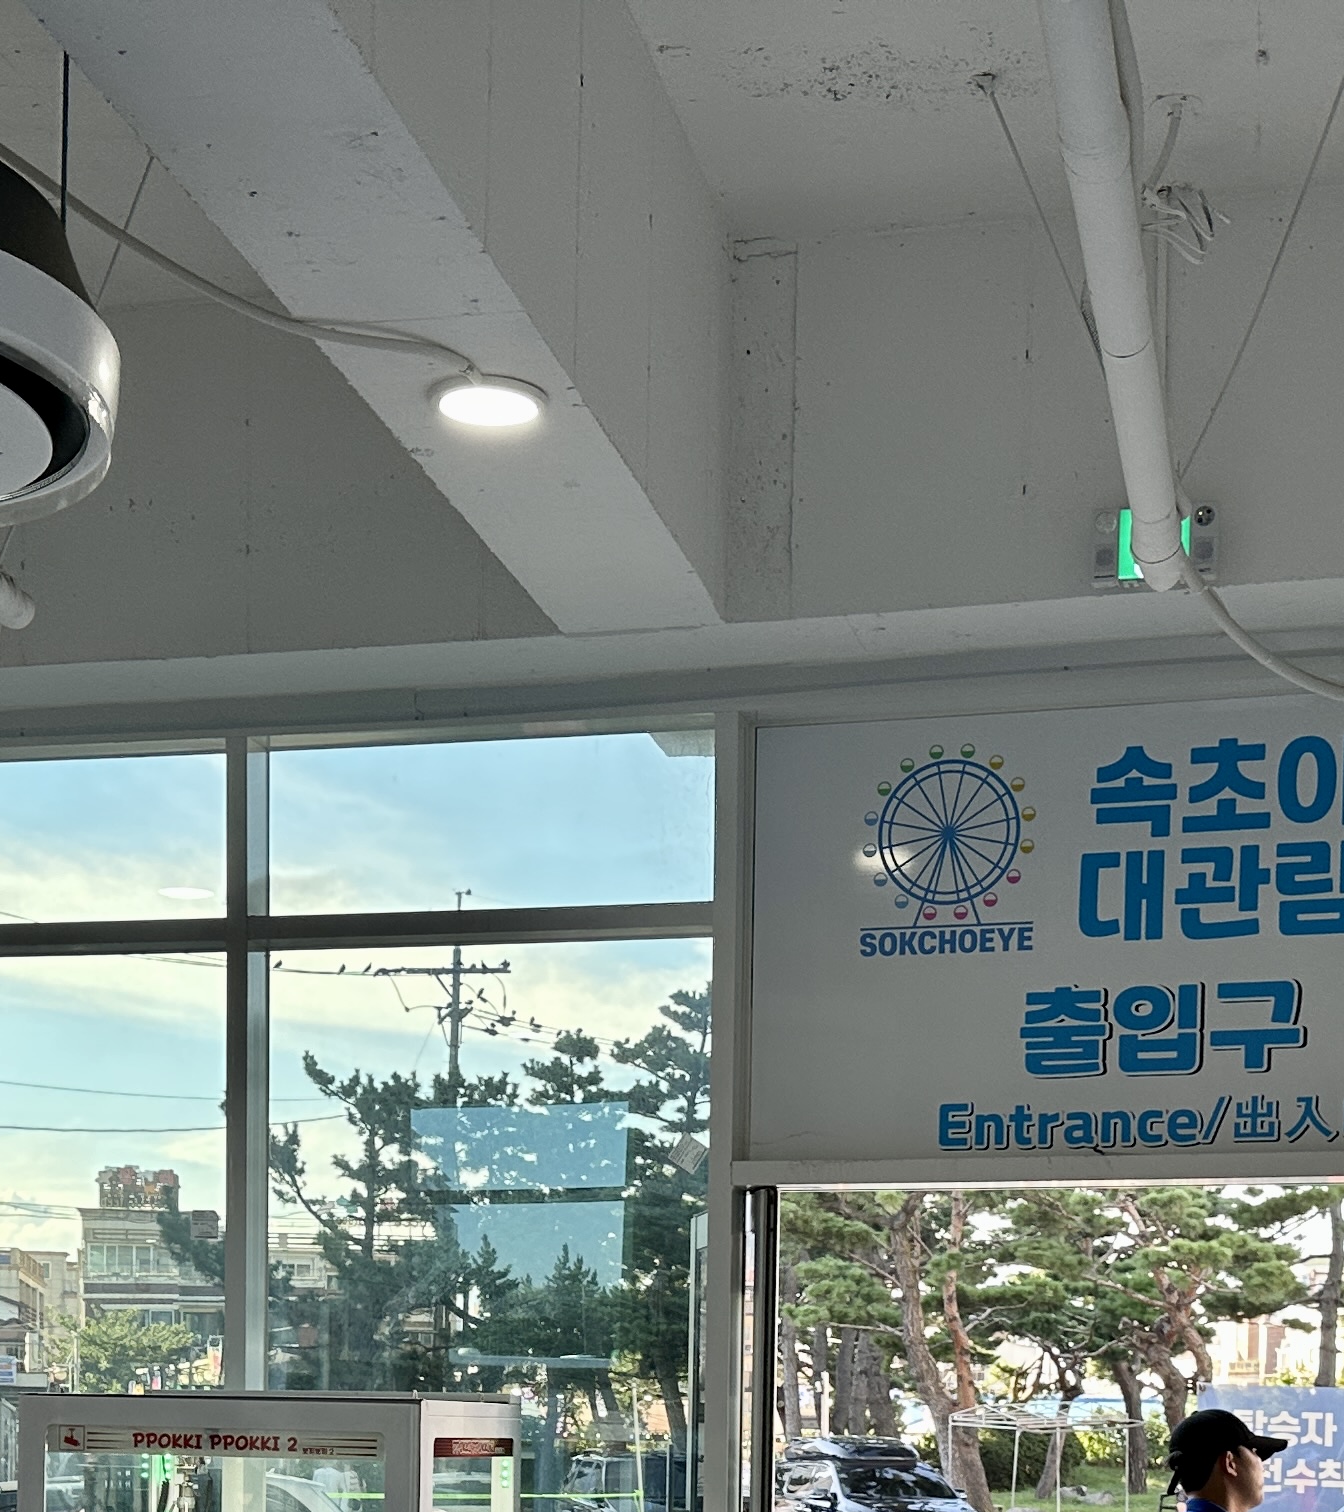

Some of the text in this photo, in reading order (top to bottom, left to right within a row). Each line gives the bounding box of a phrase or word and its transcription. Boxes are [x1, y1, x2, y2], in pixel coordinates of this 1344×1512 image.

[860, 924, 1034, 958] SOKCHOEYE
[1019, 979, 1307, 1079] 출입구
[132, 1432, 298, 1451] PPOKKI PPOKKI 2
